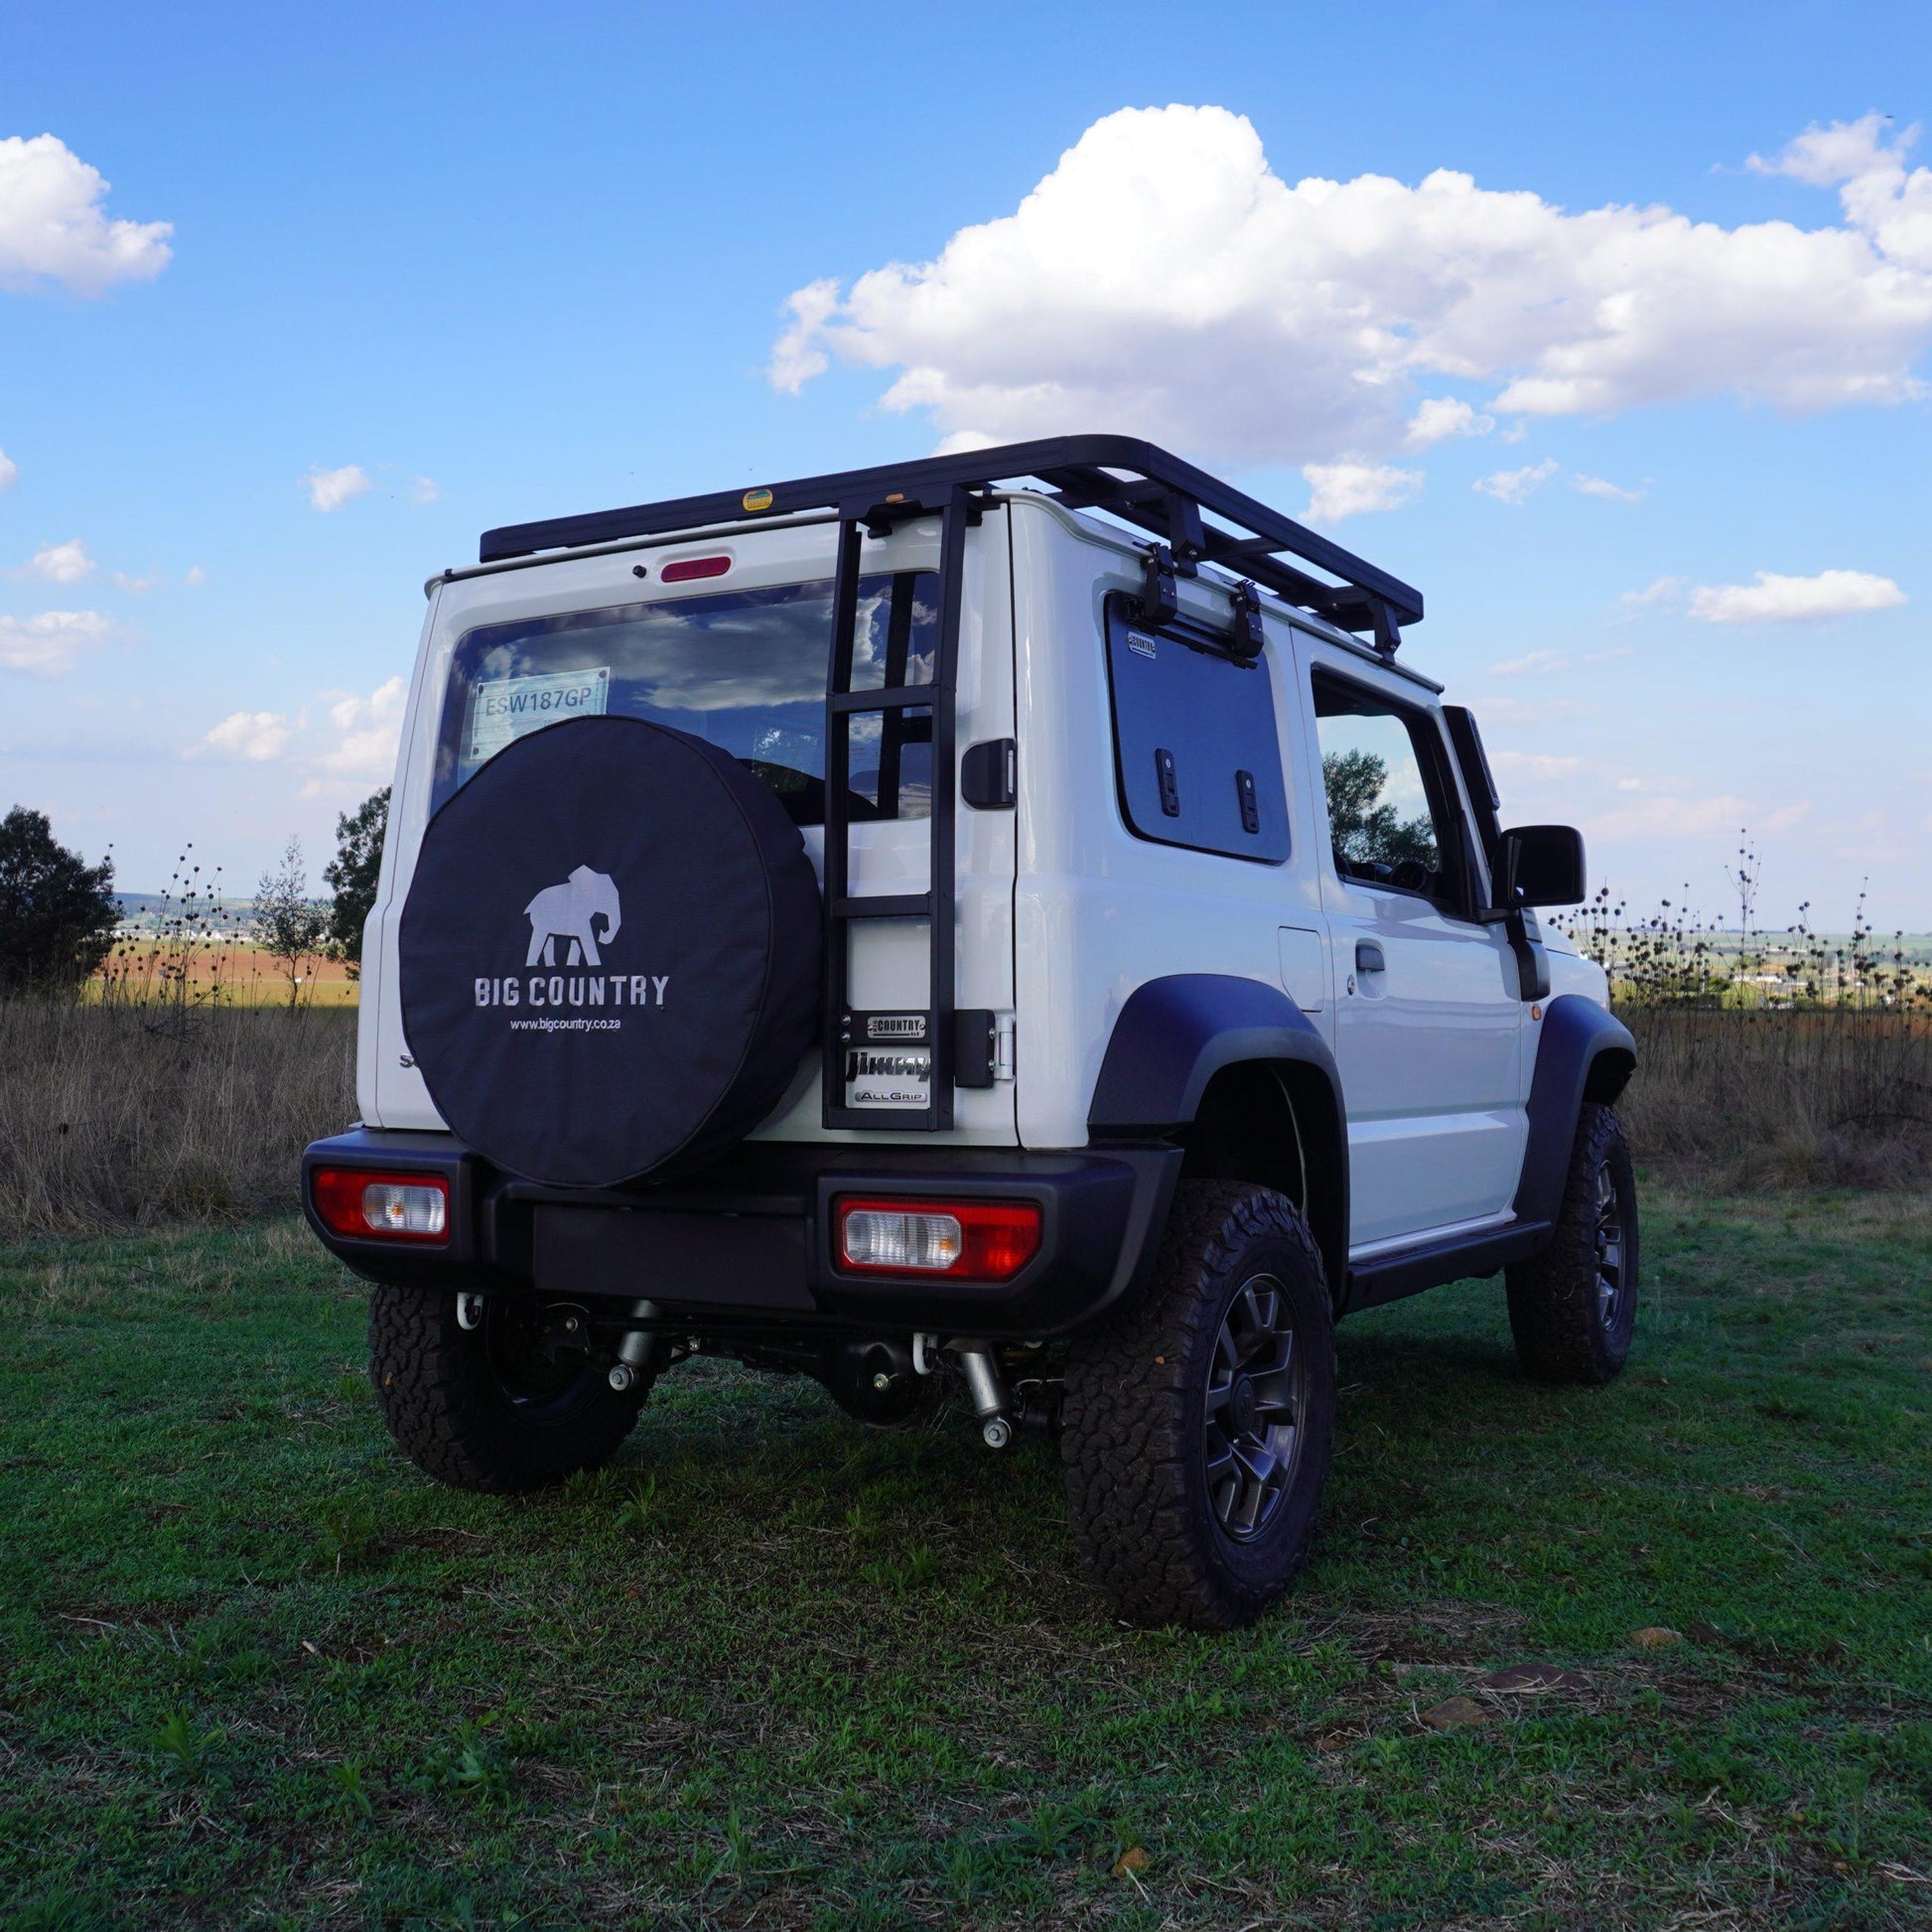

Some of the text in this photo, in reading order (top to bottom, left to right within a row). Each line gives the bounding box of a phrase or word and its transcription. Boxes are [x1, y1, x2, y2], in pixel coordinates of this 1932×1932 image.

[485, 687, 592, 716] ESW187GP
[475, 975, 670, 1007] BIG COUNTRY
[510, 1017, 621, 1033] www.bigcountry.co.za
[878, 1020, 919, 1032] COUNTRY
